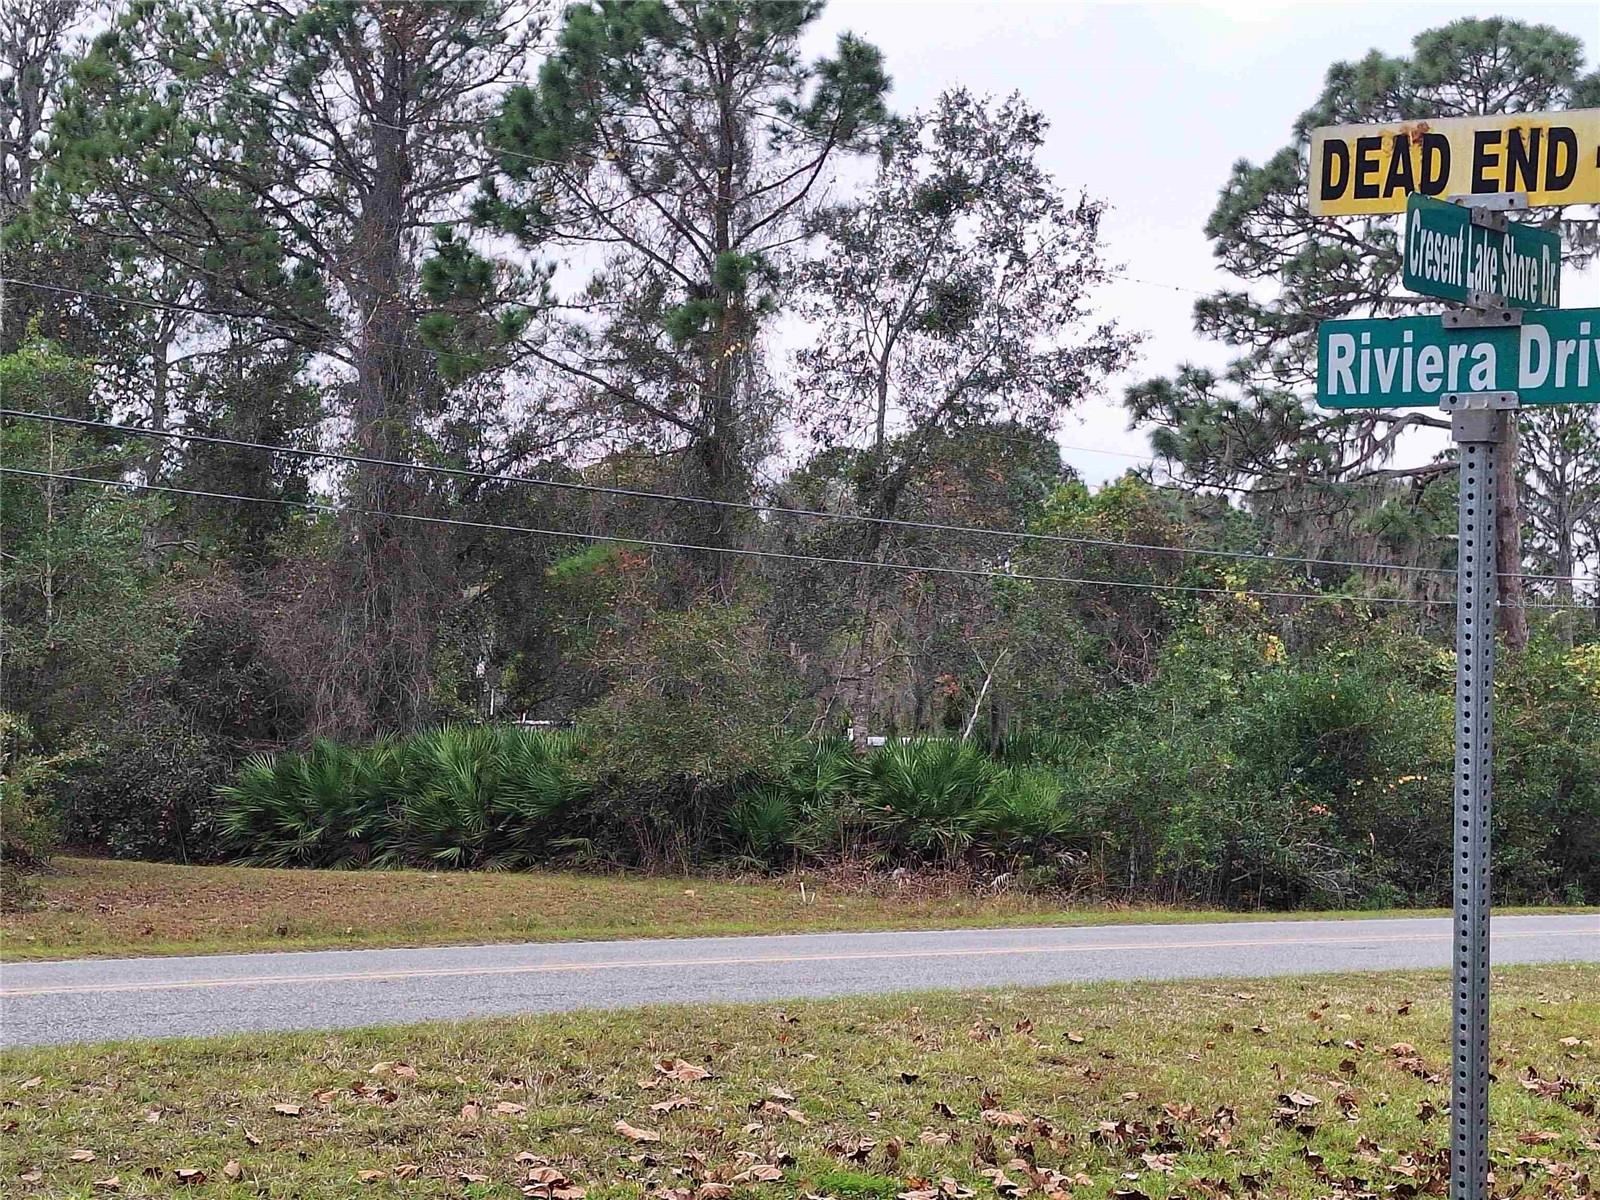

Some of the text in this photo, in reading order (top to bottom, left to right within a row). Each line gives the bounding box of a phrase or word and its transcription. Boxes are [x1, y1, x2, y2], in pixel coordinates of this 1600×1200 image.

[1320, 127, 1579, 201] DEAD END
[1409, 208, 1557, 307] Cresent Lake Shore Dr.
[1327, 321, 1600, 396] Riviera Dri
